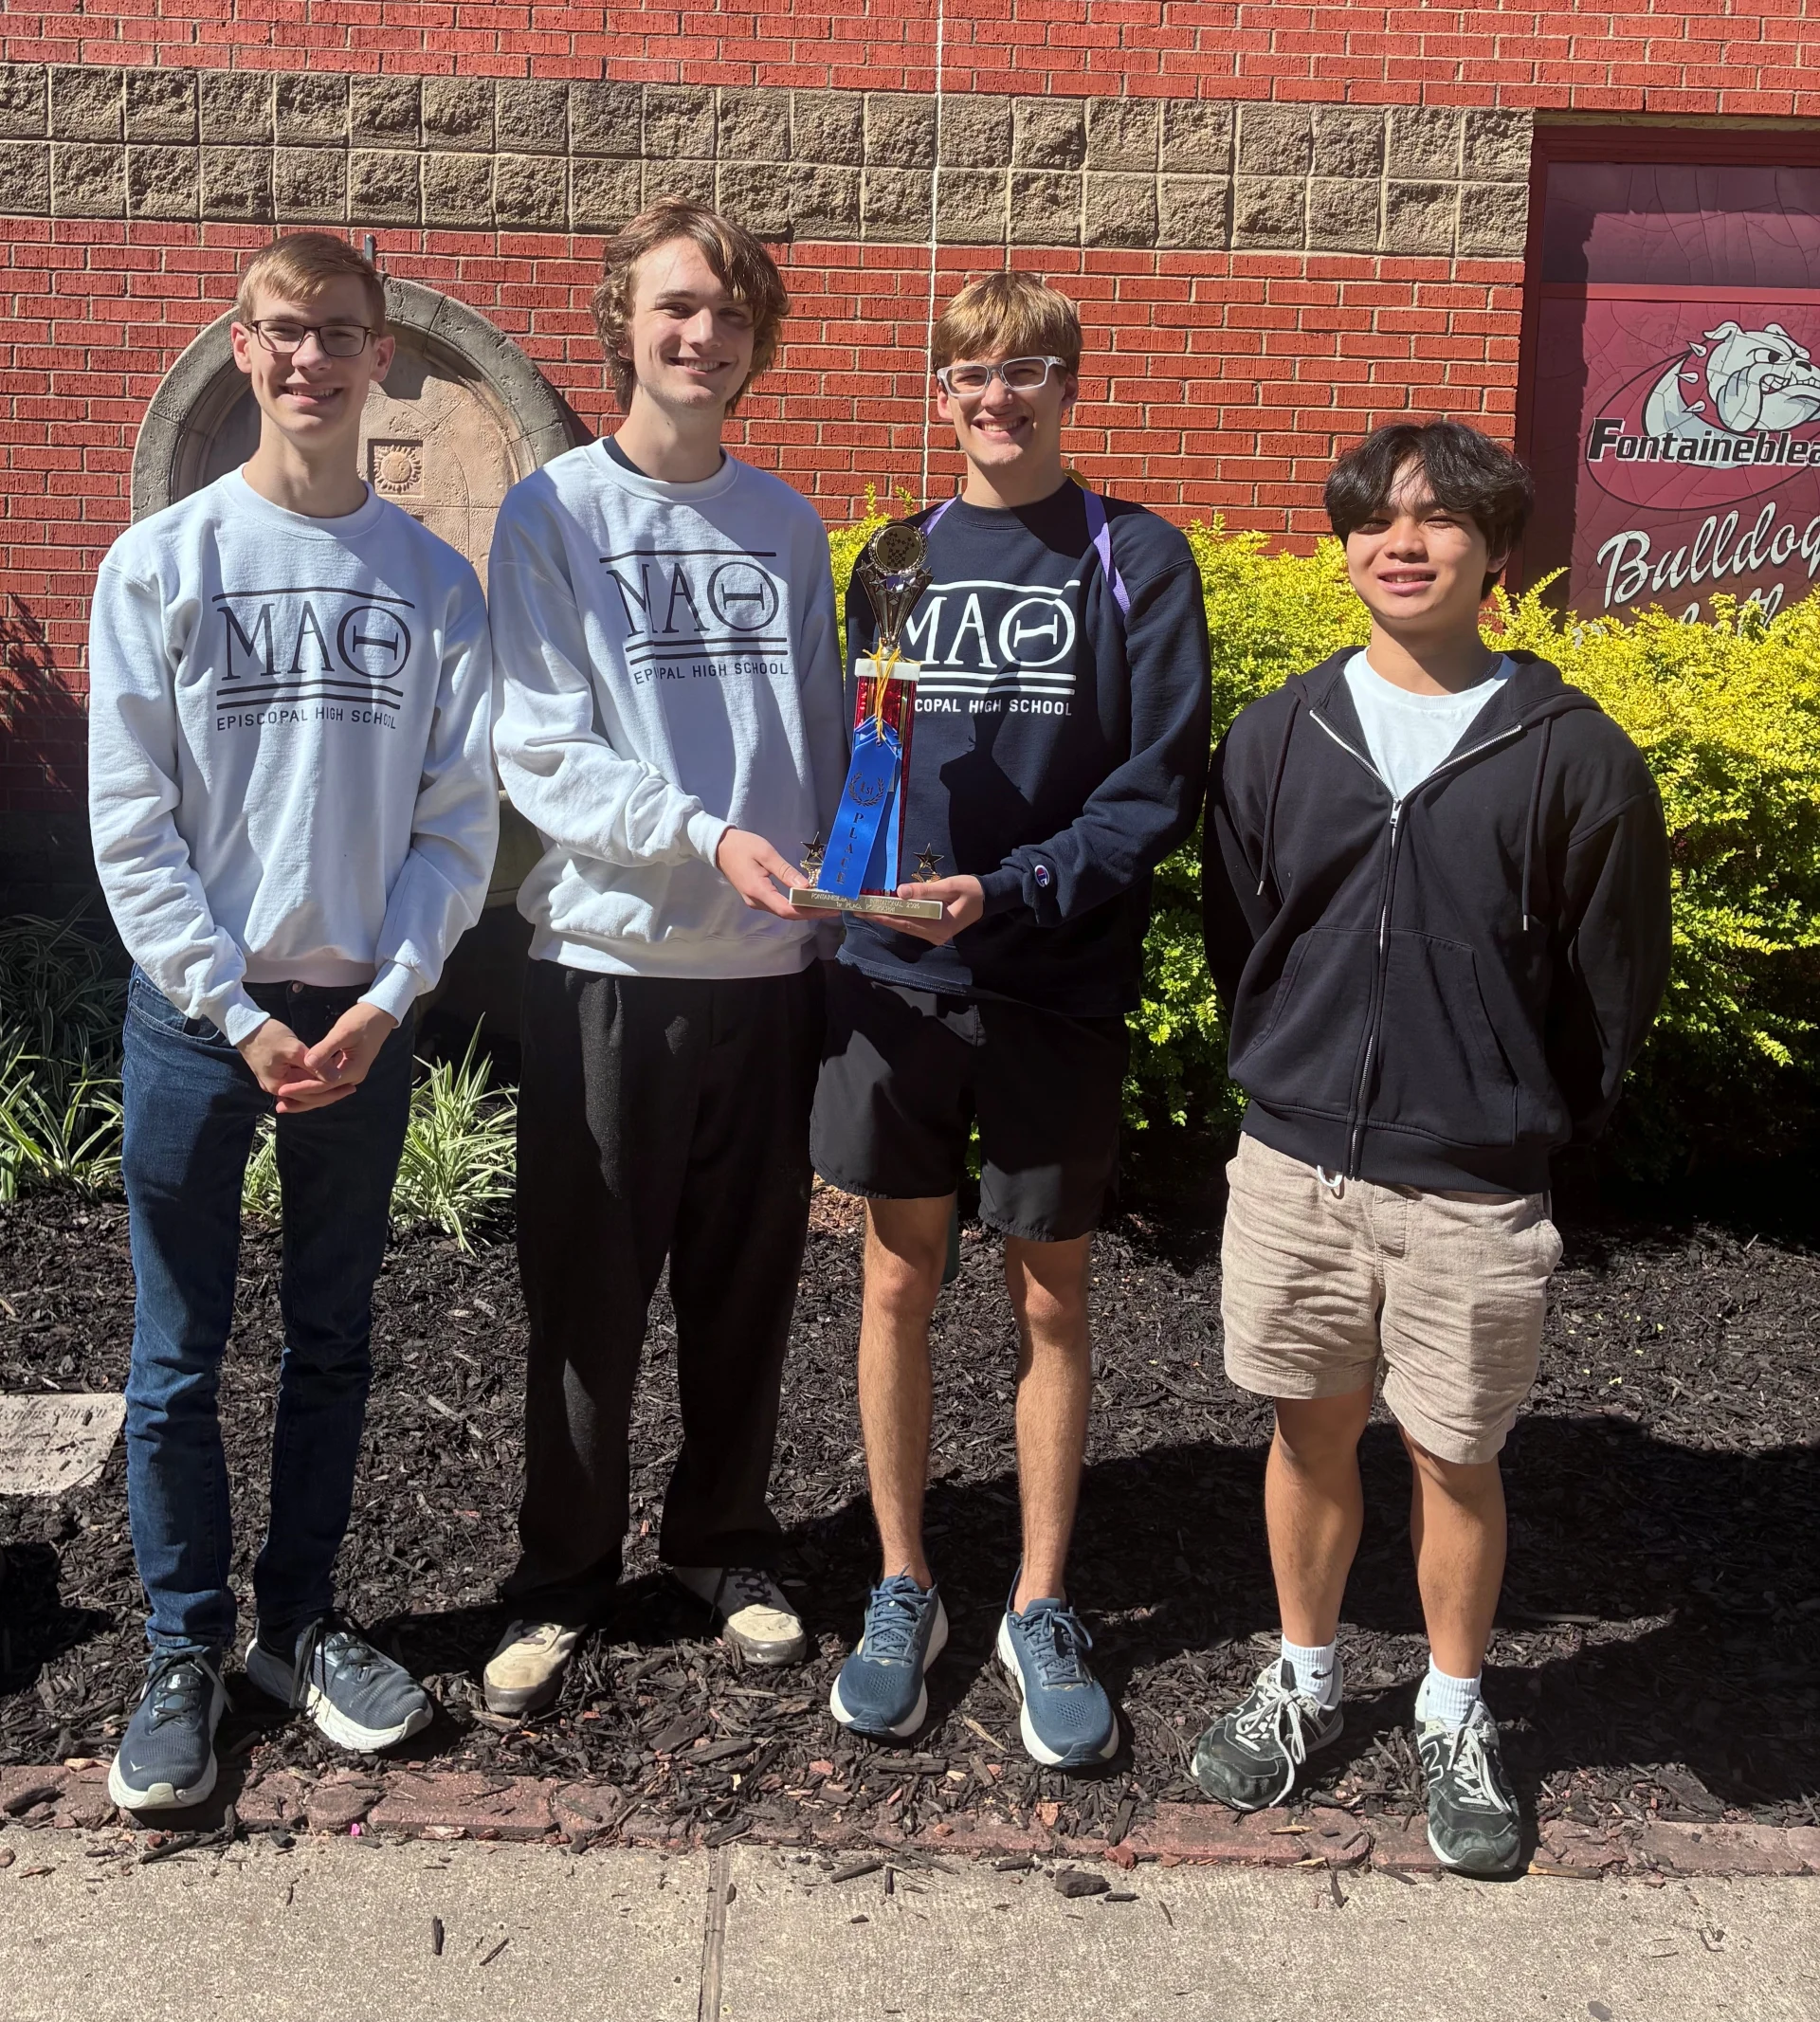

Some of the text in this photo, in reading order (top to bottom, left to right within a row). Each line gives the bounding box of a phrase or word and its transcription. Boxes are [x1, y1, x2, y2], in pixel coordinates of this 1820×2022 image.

[692, 665, 727, 678] HIGH
[735, 663, 789, 675] SCHOOL
[915, 699, 1072, 716] COPAL HIGH SCHOOL
[217, 707, 396, 731] EPISCOPAL HIGH SCHOOL
